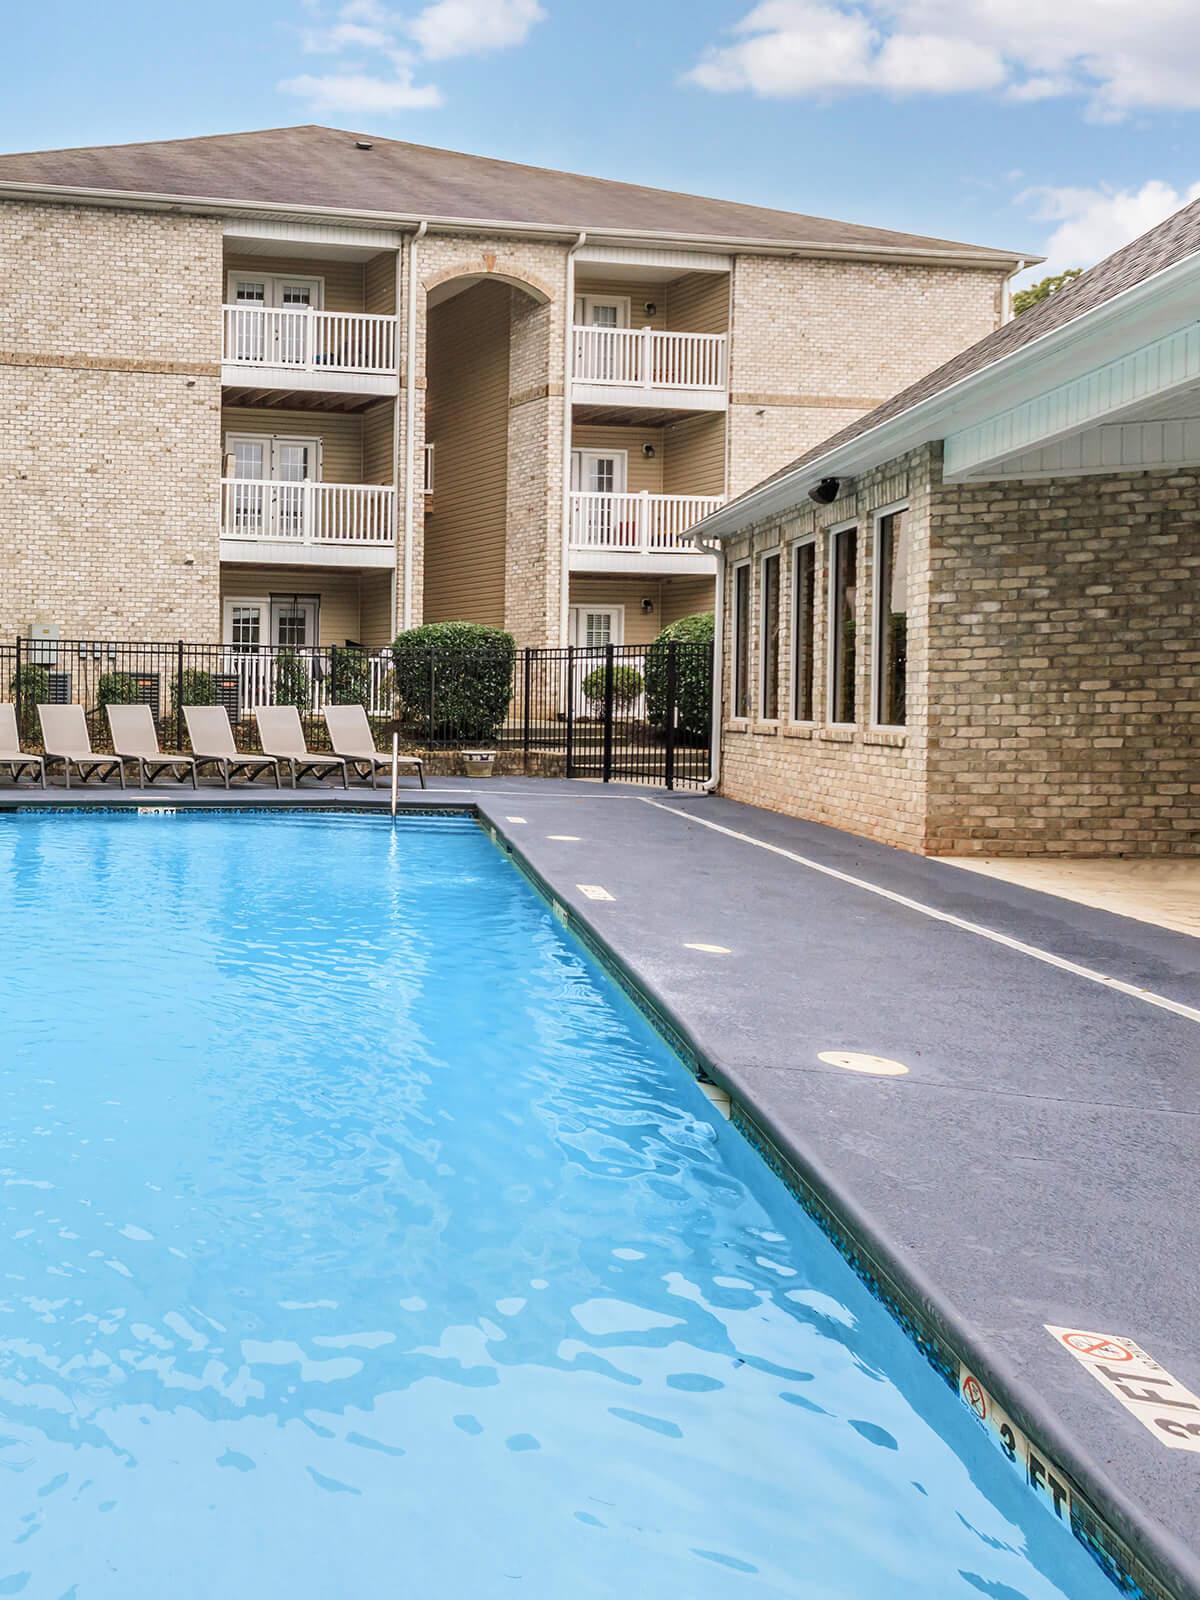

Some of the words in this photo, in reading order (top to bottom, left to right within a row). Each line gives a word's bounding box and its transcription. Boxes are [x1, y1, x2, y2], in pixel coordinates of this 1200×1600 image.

[1094, 1363, 1200, 1411] FT
[1000, 1423, 1017, 1463] 3
[1029, 1452, 1068, 1521] FT
